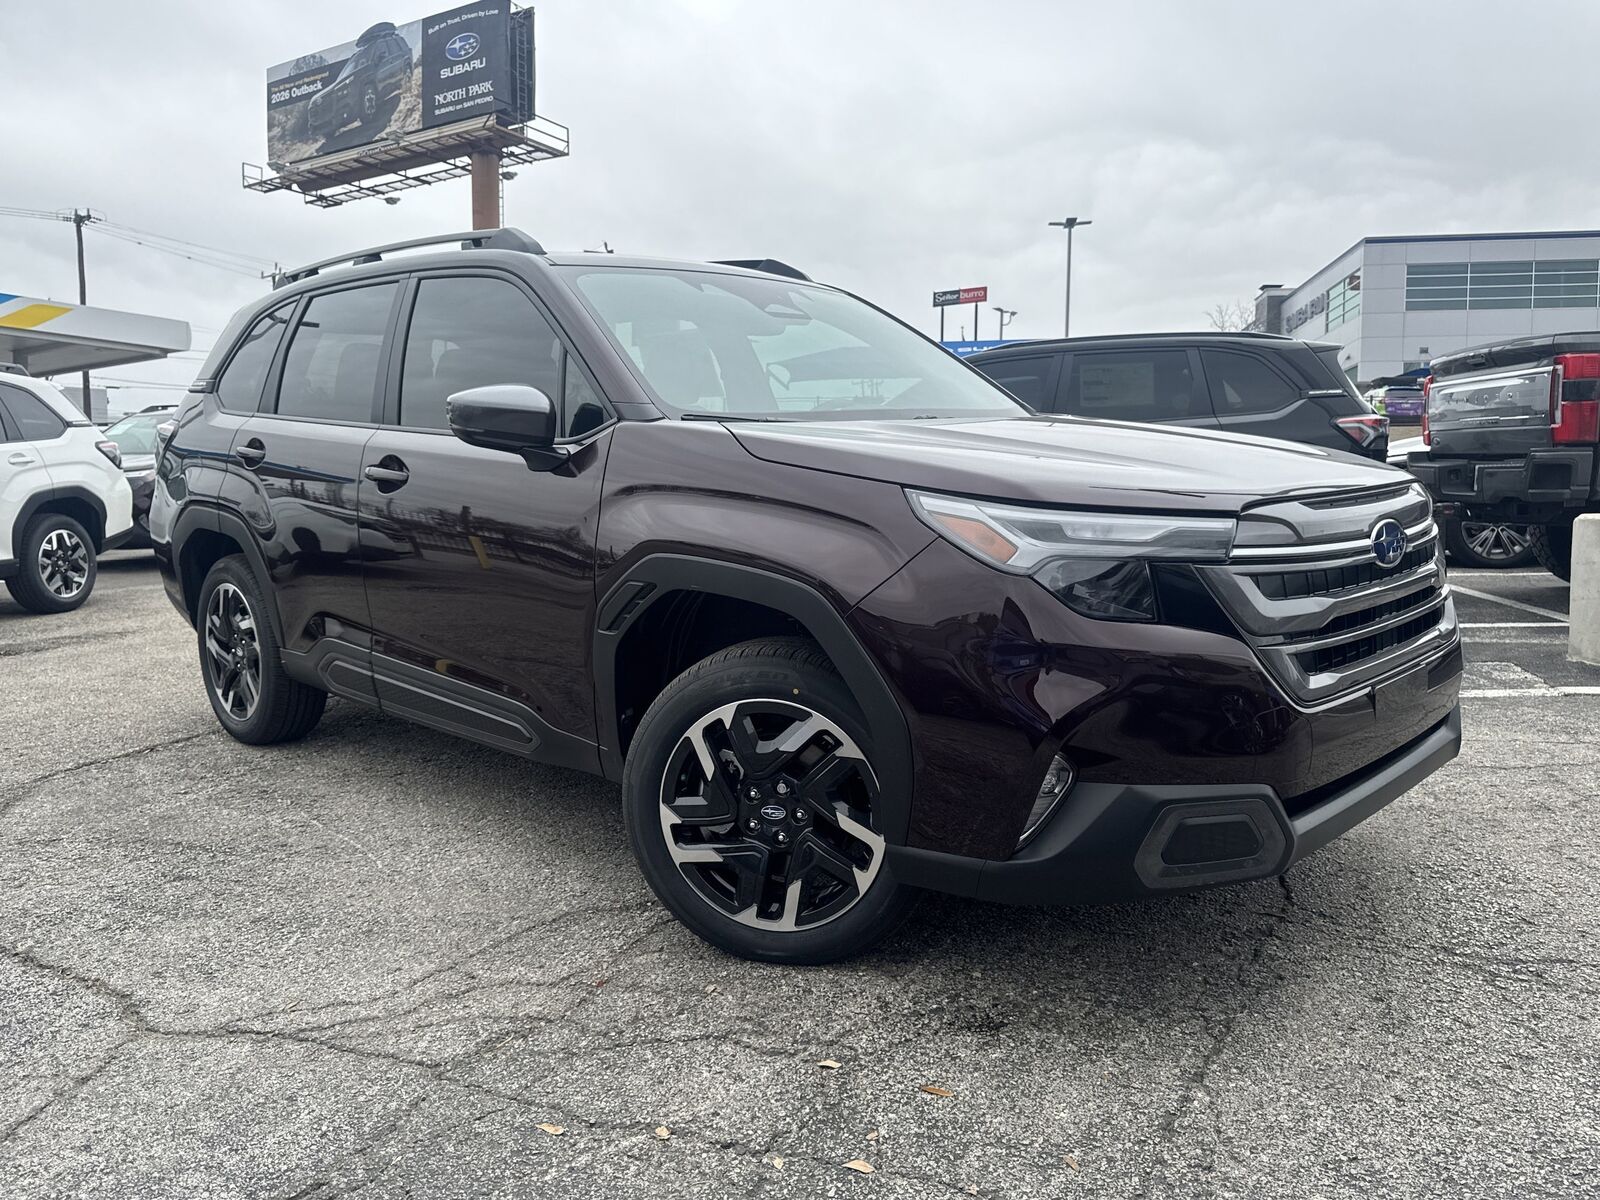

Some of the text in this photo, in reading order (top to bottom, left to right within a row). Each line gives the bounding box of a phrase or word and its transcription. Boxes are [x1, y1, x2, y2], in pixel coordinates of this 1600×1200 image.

[428, 25, 439, 34] Built
[461, 12, 478, 21] Driven
[440, 57, 486, 79] SUBARU
[271, 80, 323, 104] 2026 Outback
[434, 80, 494, 106] NORTH PARK
[434, 105, 456, 116] SUBARU
[463, 99, 475, 108] SAN
[475, 95, 494, 105] PEDRO
[960, 290, 984, 299] burro
[1285, 293, 1325, 334] SUBARU
